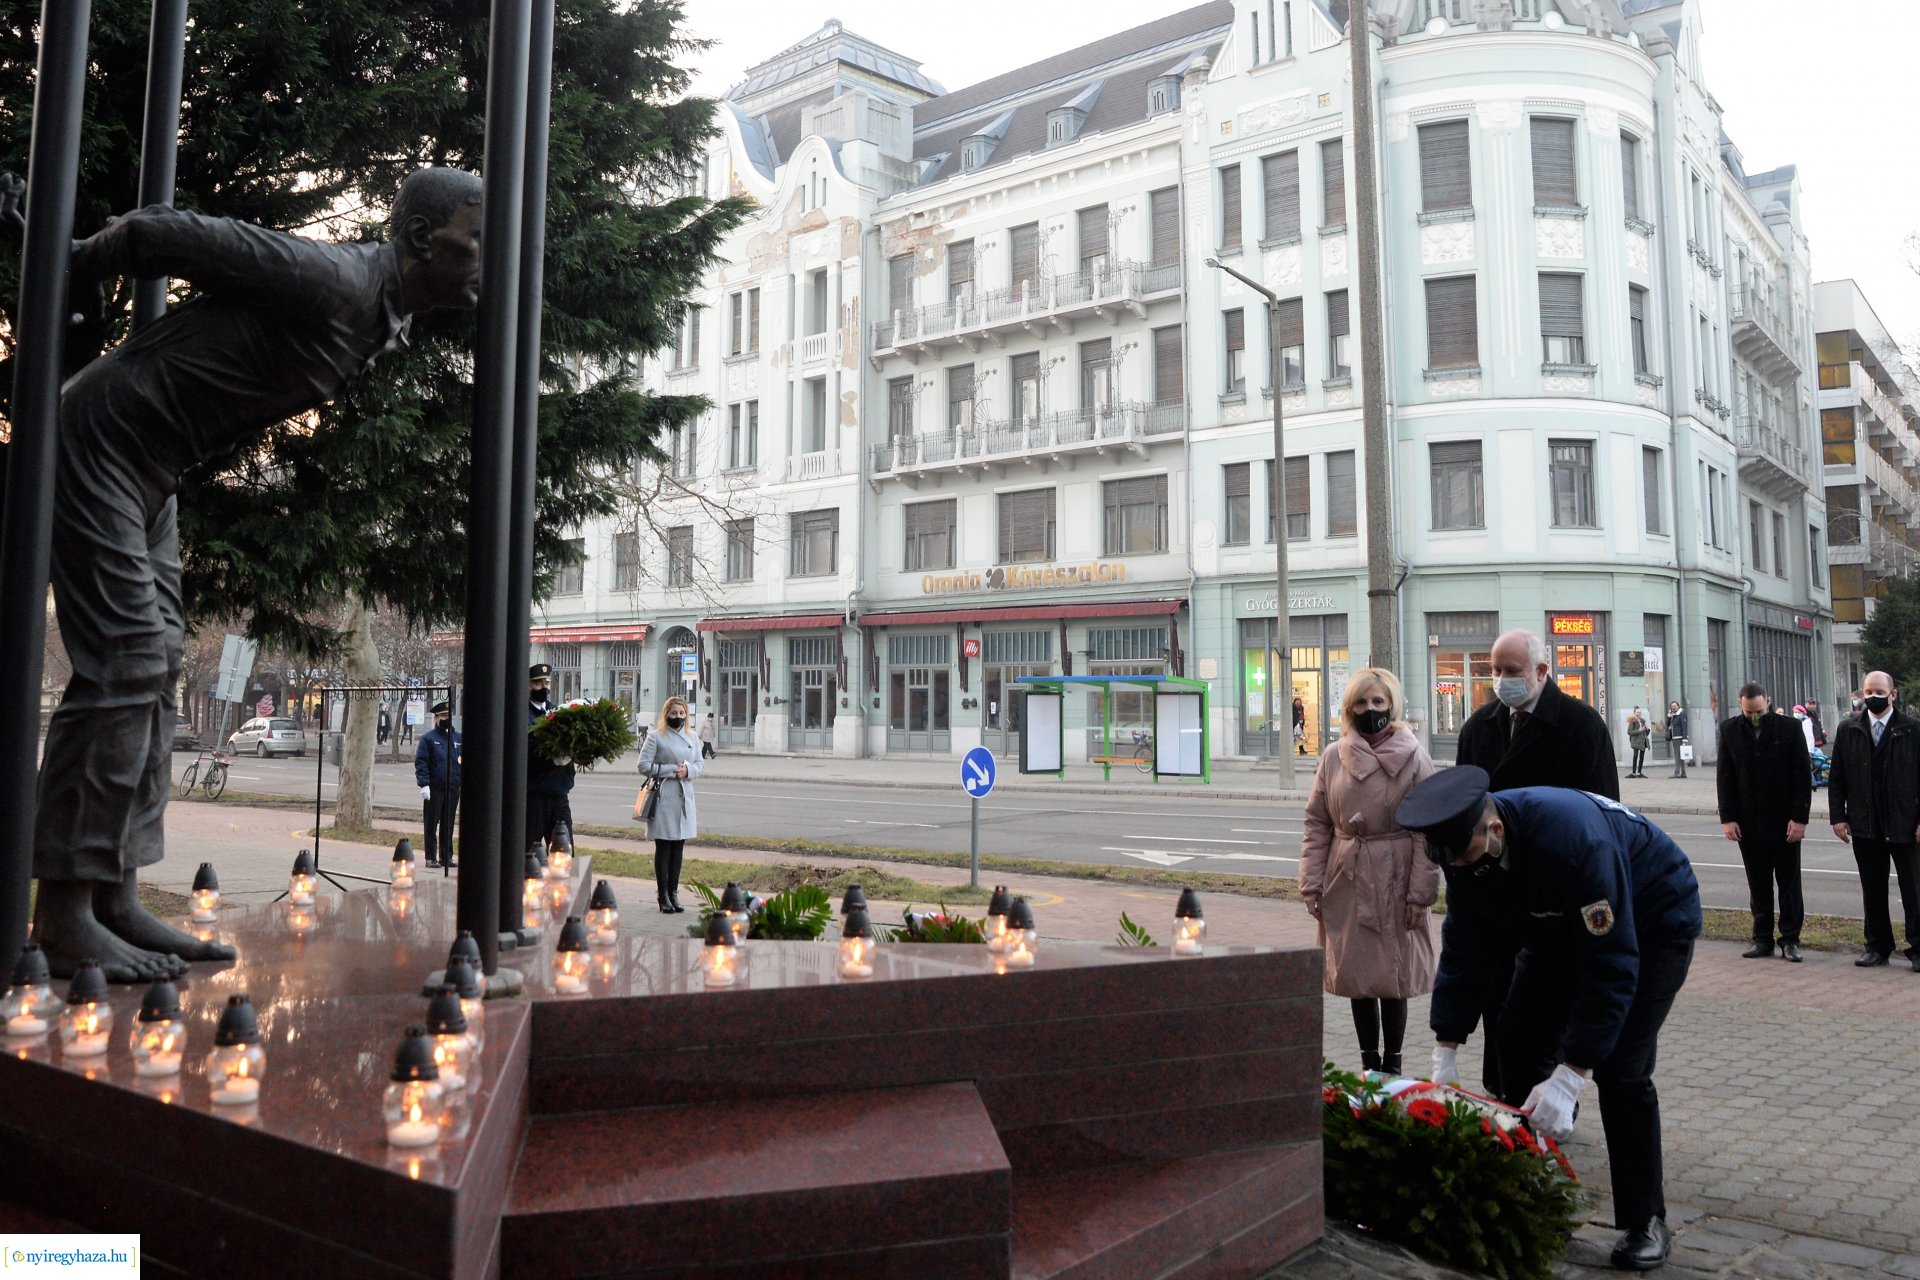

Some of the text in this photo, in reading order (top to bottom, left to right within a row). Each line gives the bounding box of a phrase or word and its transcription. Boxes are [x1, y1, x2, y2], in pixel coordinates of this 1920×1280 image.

[921, 570, 982, 594] Omnia
[1245, 594, 1336, 611] GYÓGZERTÁR
[1554, 619, 1591, 632] PÉKSÉG
[1598, 647, 1606, 715] PÉKSÉ
